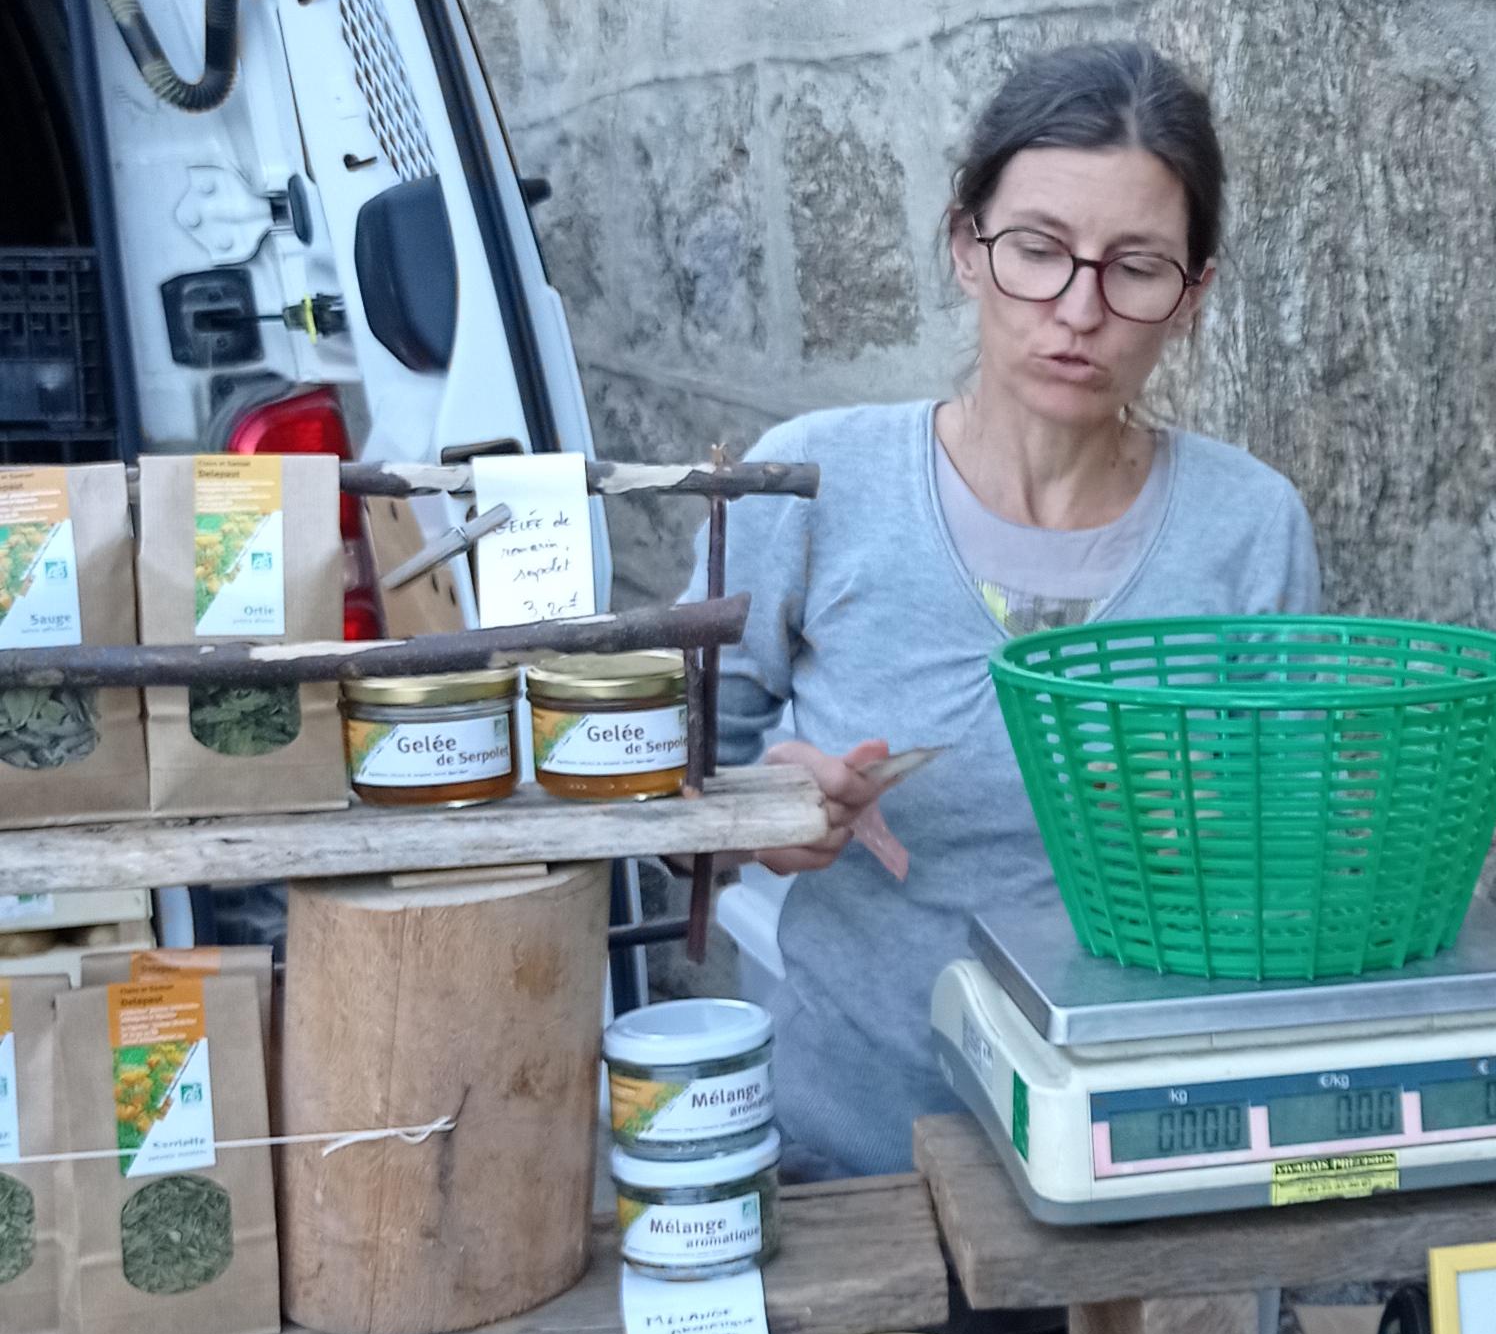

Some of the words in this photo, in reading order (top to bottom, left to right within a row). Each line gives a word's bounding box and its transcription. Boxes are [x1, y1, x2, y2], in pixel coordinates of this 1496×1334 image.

[553, 510, 570, 528] de
[30, 614, 73, 627] Sauge
[243, 605, 275, 617] Ortie
[587, 723, 645, 743] Gelée
[397, 734, 457, 754] Gelée
[625, 742, 643, 755] de
[436, 754, 455, 767] de
[458, 745, 509, 765] Serpolet
[1170, 1088, 1188, 1105] kg
[1319, 1073, 1350, 1090] €/kg
[1478, 1059, 1489, 1075] €
[691, 1082, 761, 1109] Mélange
[649, 1218, 727, 1236] Mélange
[686, 1226, 760, 1248] aromatique
